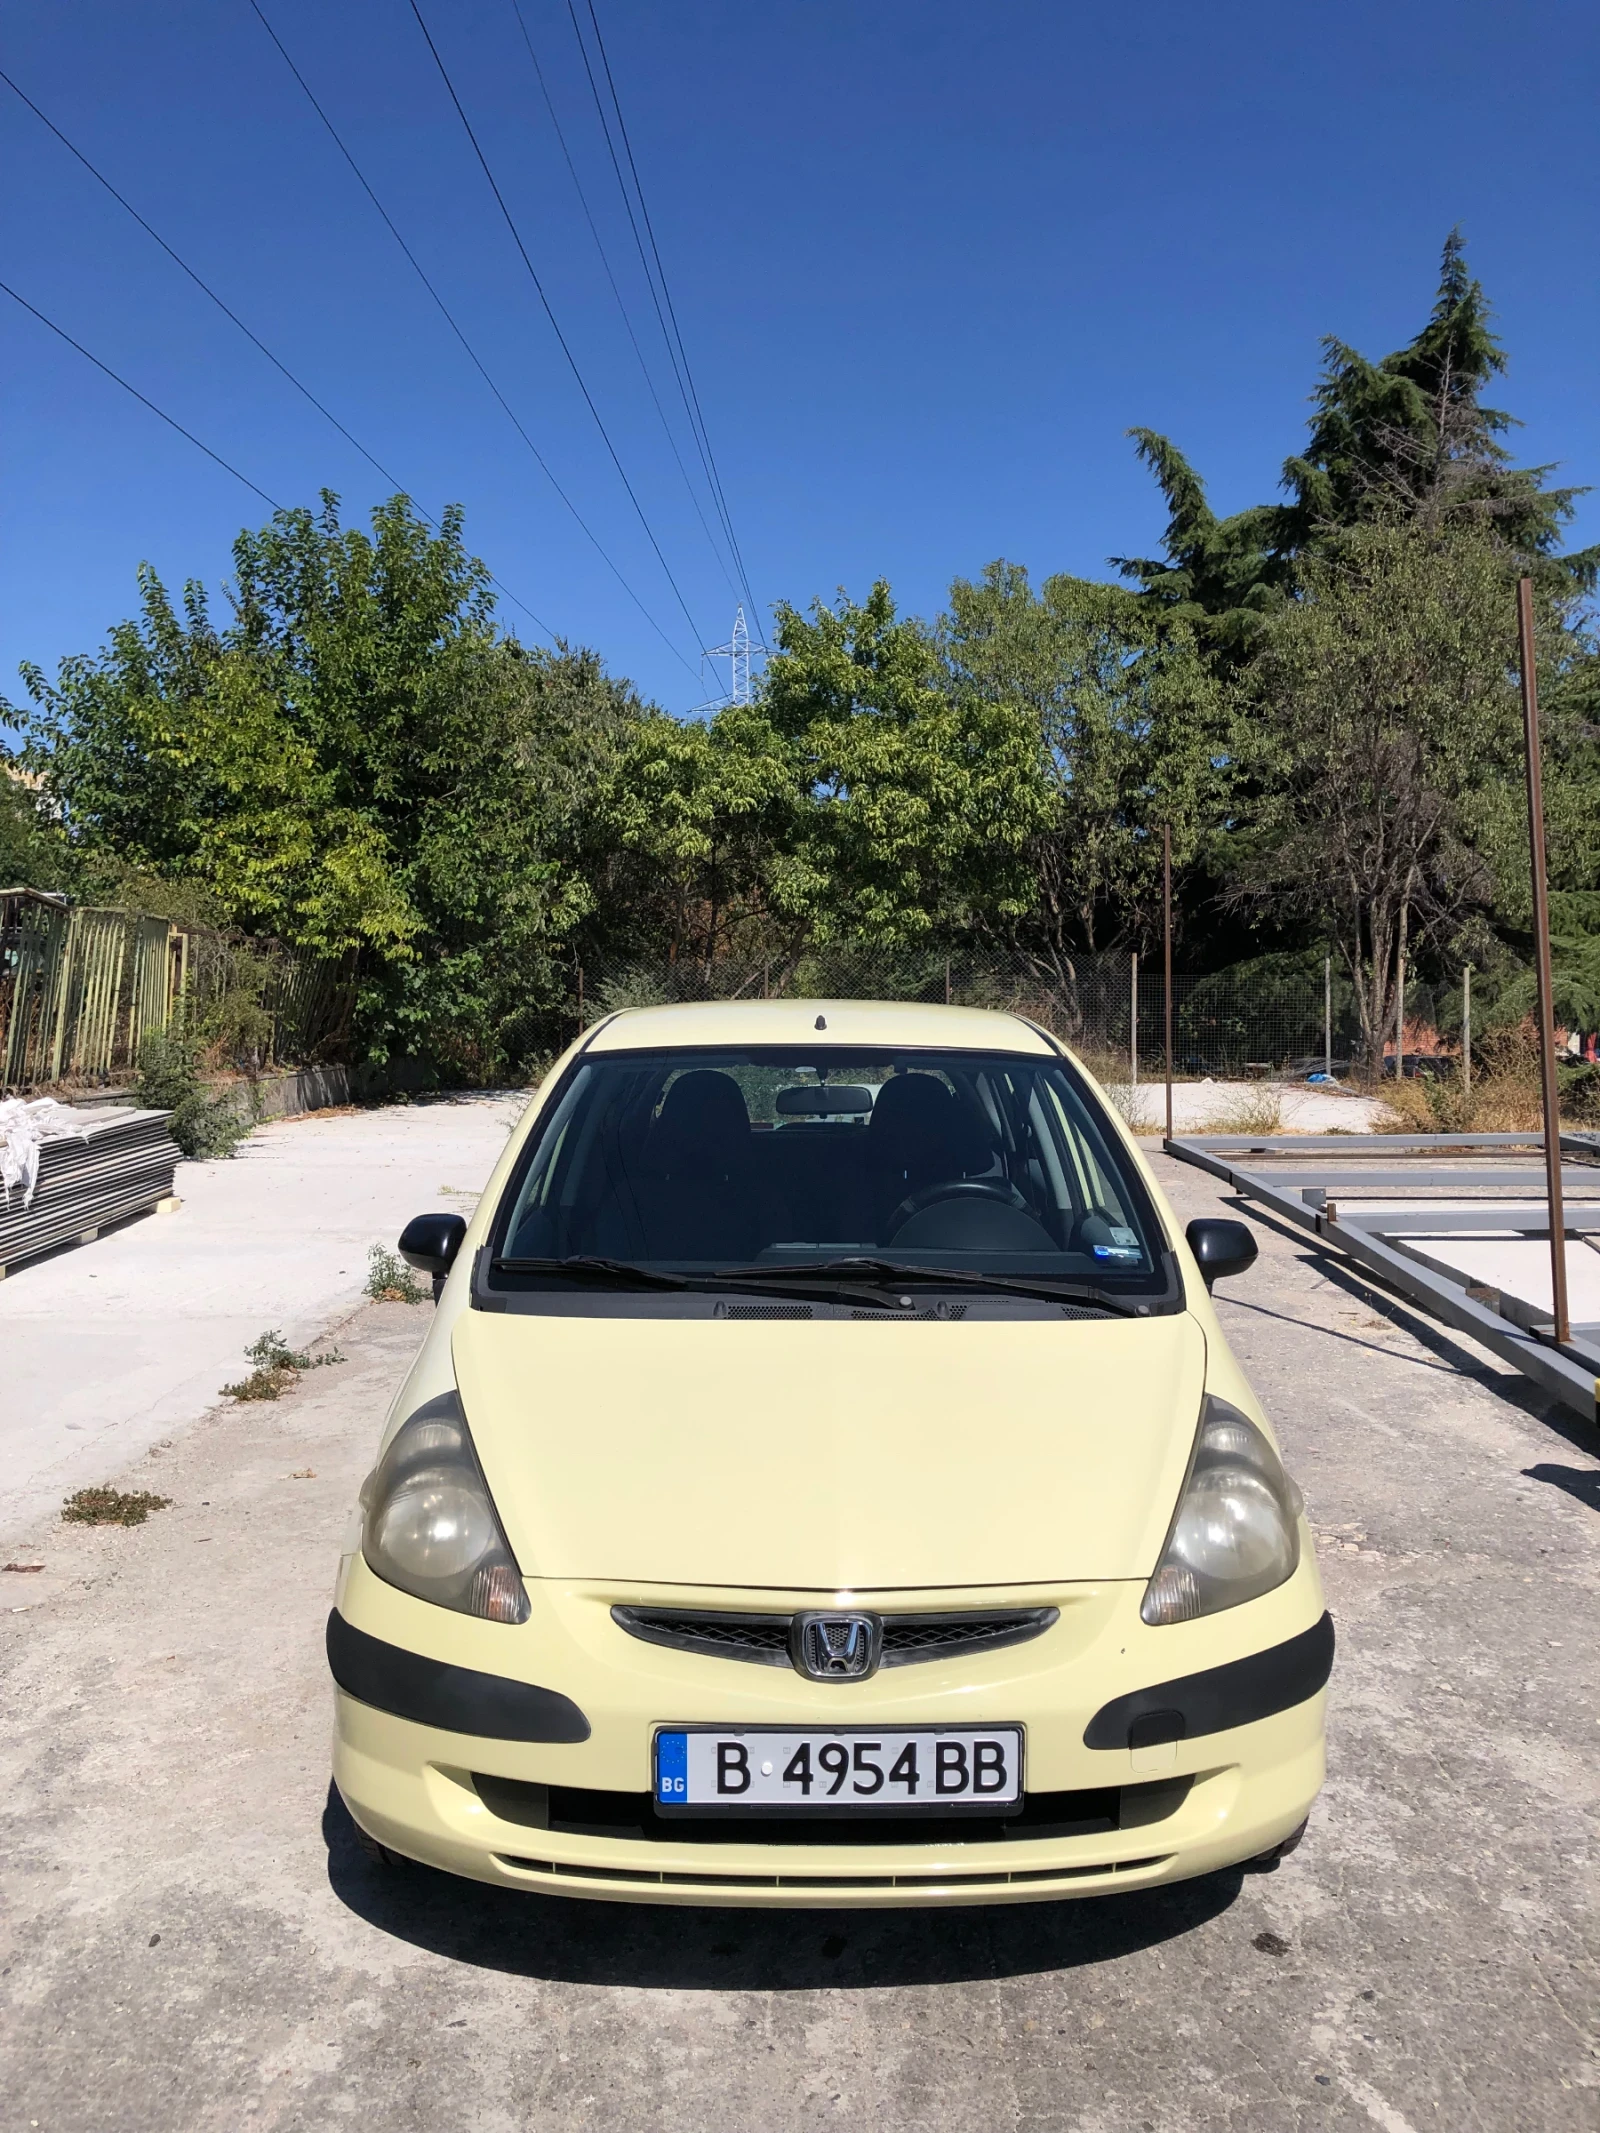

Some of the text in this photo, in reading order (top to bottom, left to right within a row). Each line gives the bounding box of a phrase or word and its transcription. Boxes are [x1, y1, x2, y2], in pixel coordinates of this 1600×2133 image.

[661, 1777, 685, 1793] BG
[717, 1740, 1007, 1795] B 4954 BB
